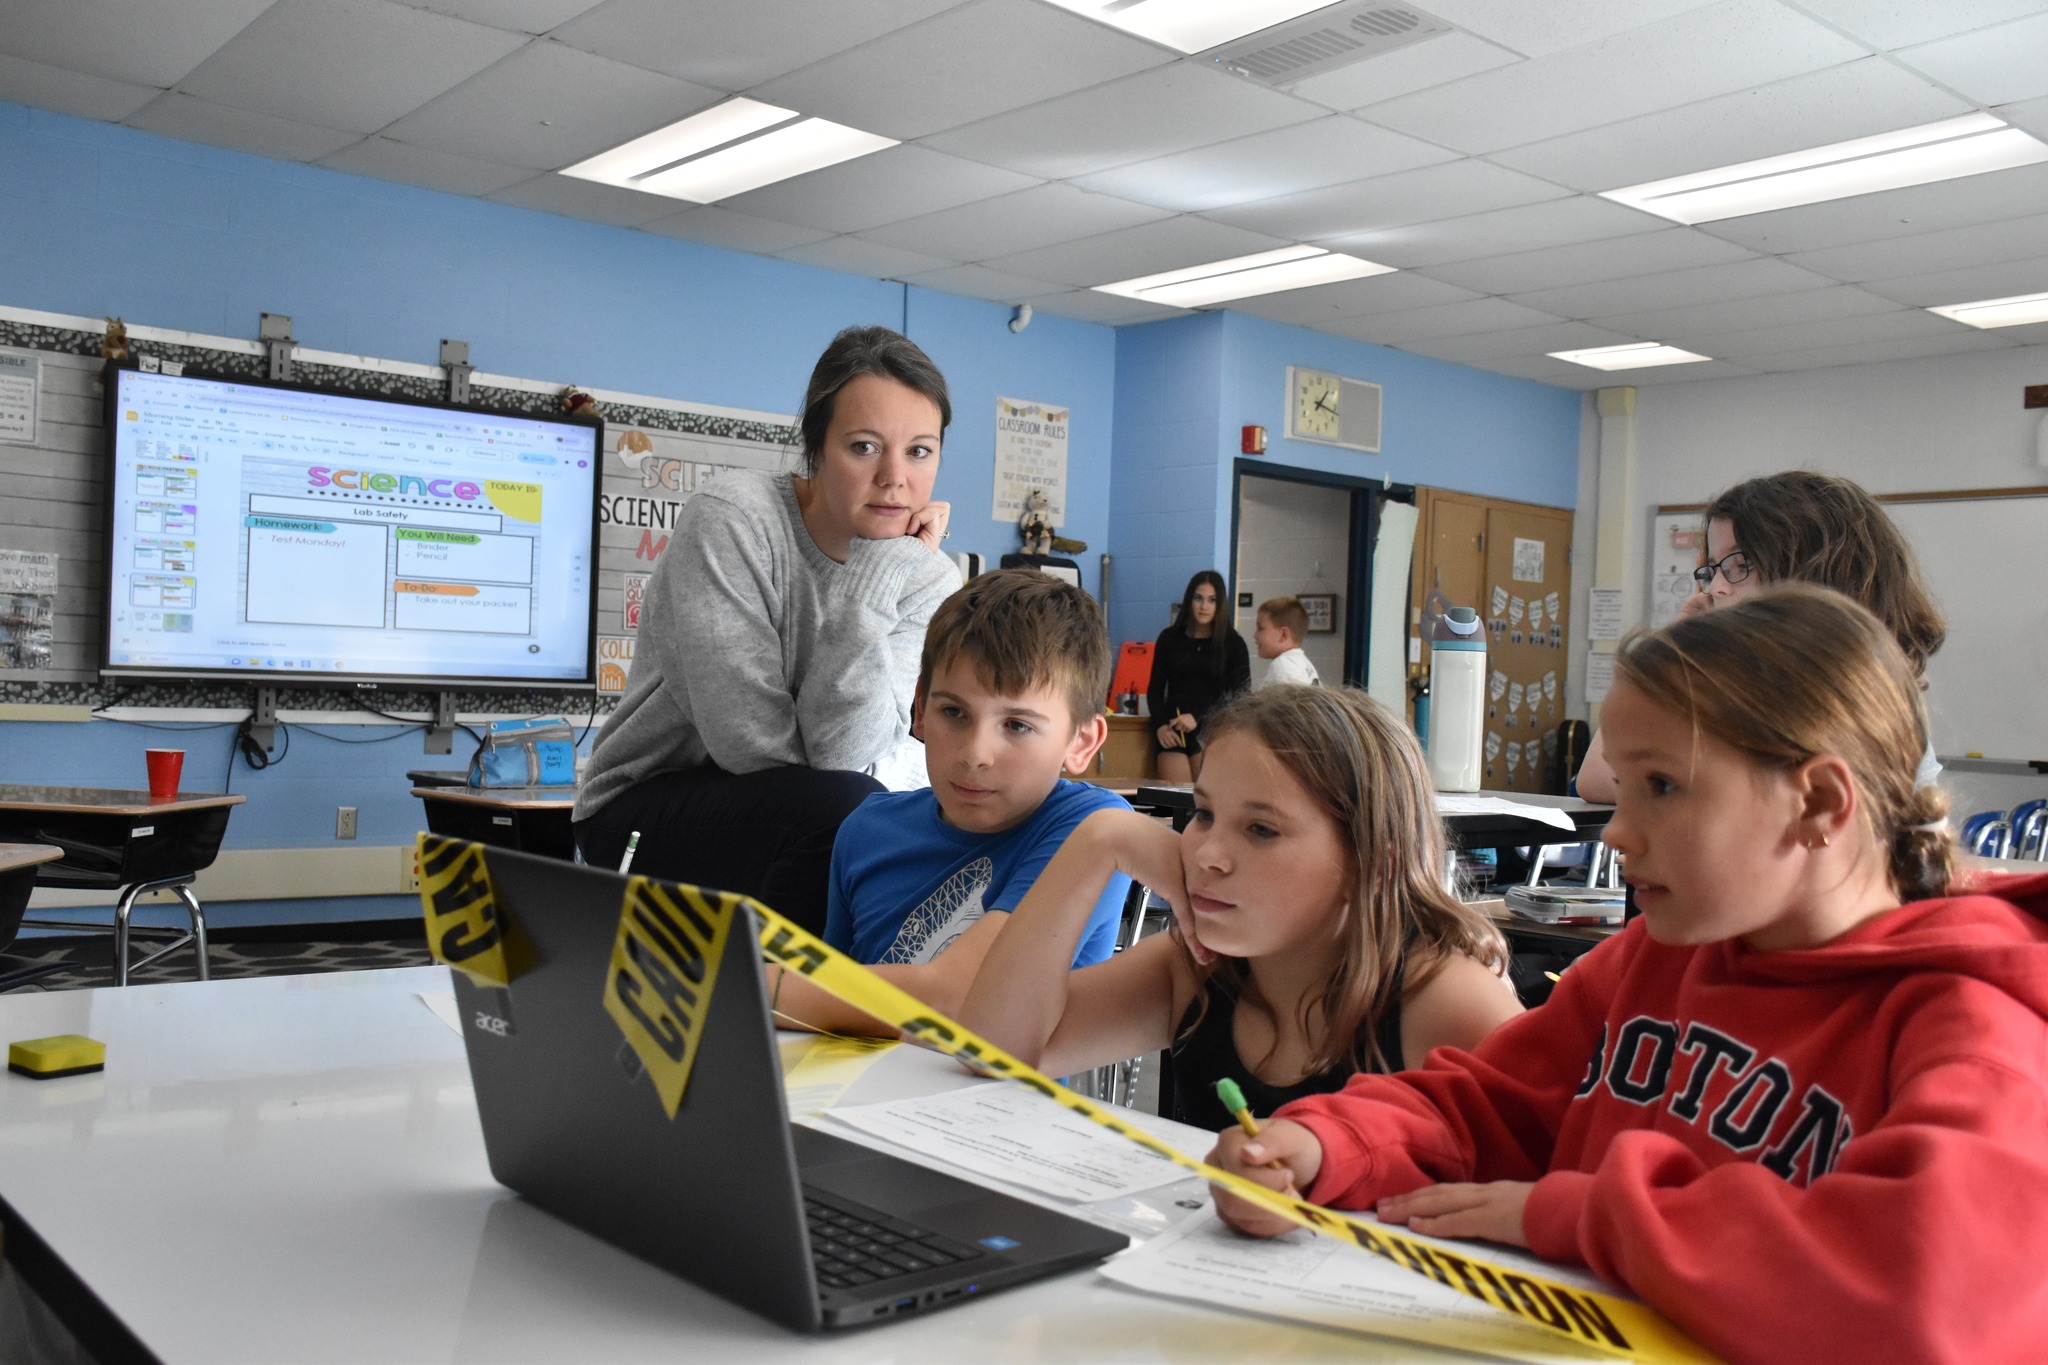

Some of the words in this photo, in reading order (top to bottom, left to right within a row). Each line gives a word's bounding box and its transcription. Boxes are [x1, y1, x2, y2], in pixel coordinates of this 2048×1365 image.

[999, 417, 1040, 435] CLASSROOM
[1044, 424, 1066, 440] RULES
[641, 456, 727, 493] SCIE
[491, 482, 523, 492] TODAY
[353, 508, 373, 517] Lab
[376, 510, 409, 520] Safety
[600, 494, 686, 530] SCIENT
[271, 535, 292, 544] Test
[400, 529, 422, 539] You
[425, 531, 444, 541] Will
[417, 543, 449, 551] Binder
[0, 552, 17, 561] ove
[21, 554, 48, 565] math
[417, 552, 448, 561] Pencil
[415, 596, 438, 605] Take
[441, 597, 457, 605] out
[459, 599, 481, 609] your
[483, 600, 518, 609] packet
[475, 1011, 509, 1036] acer
